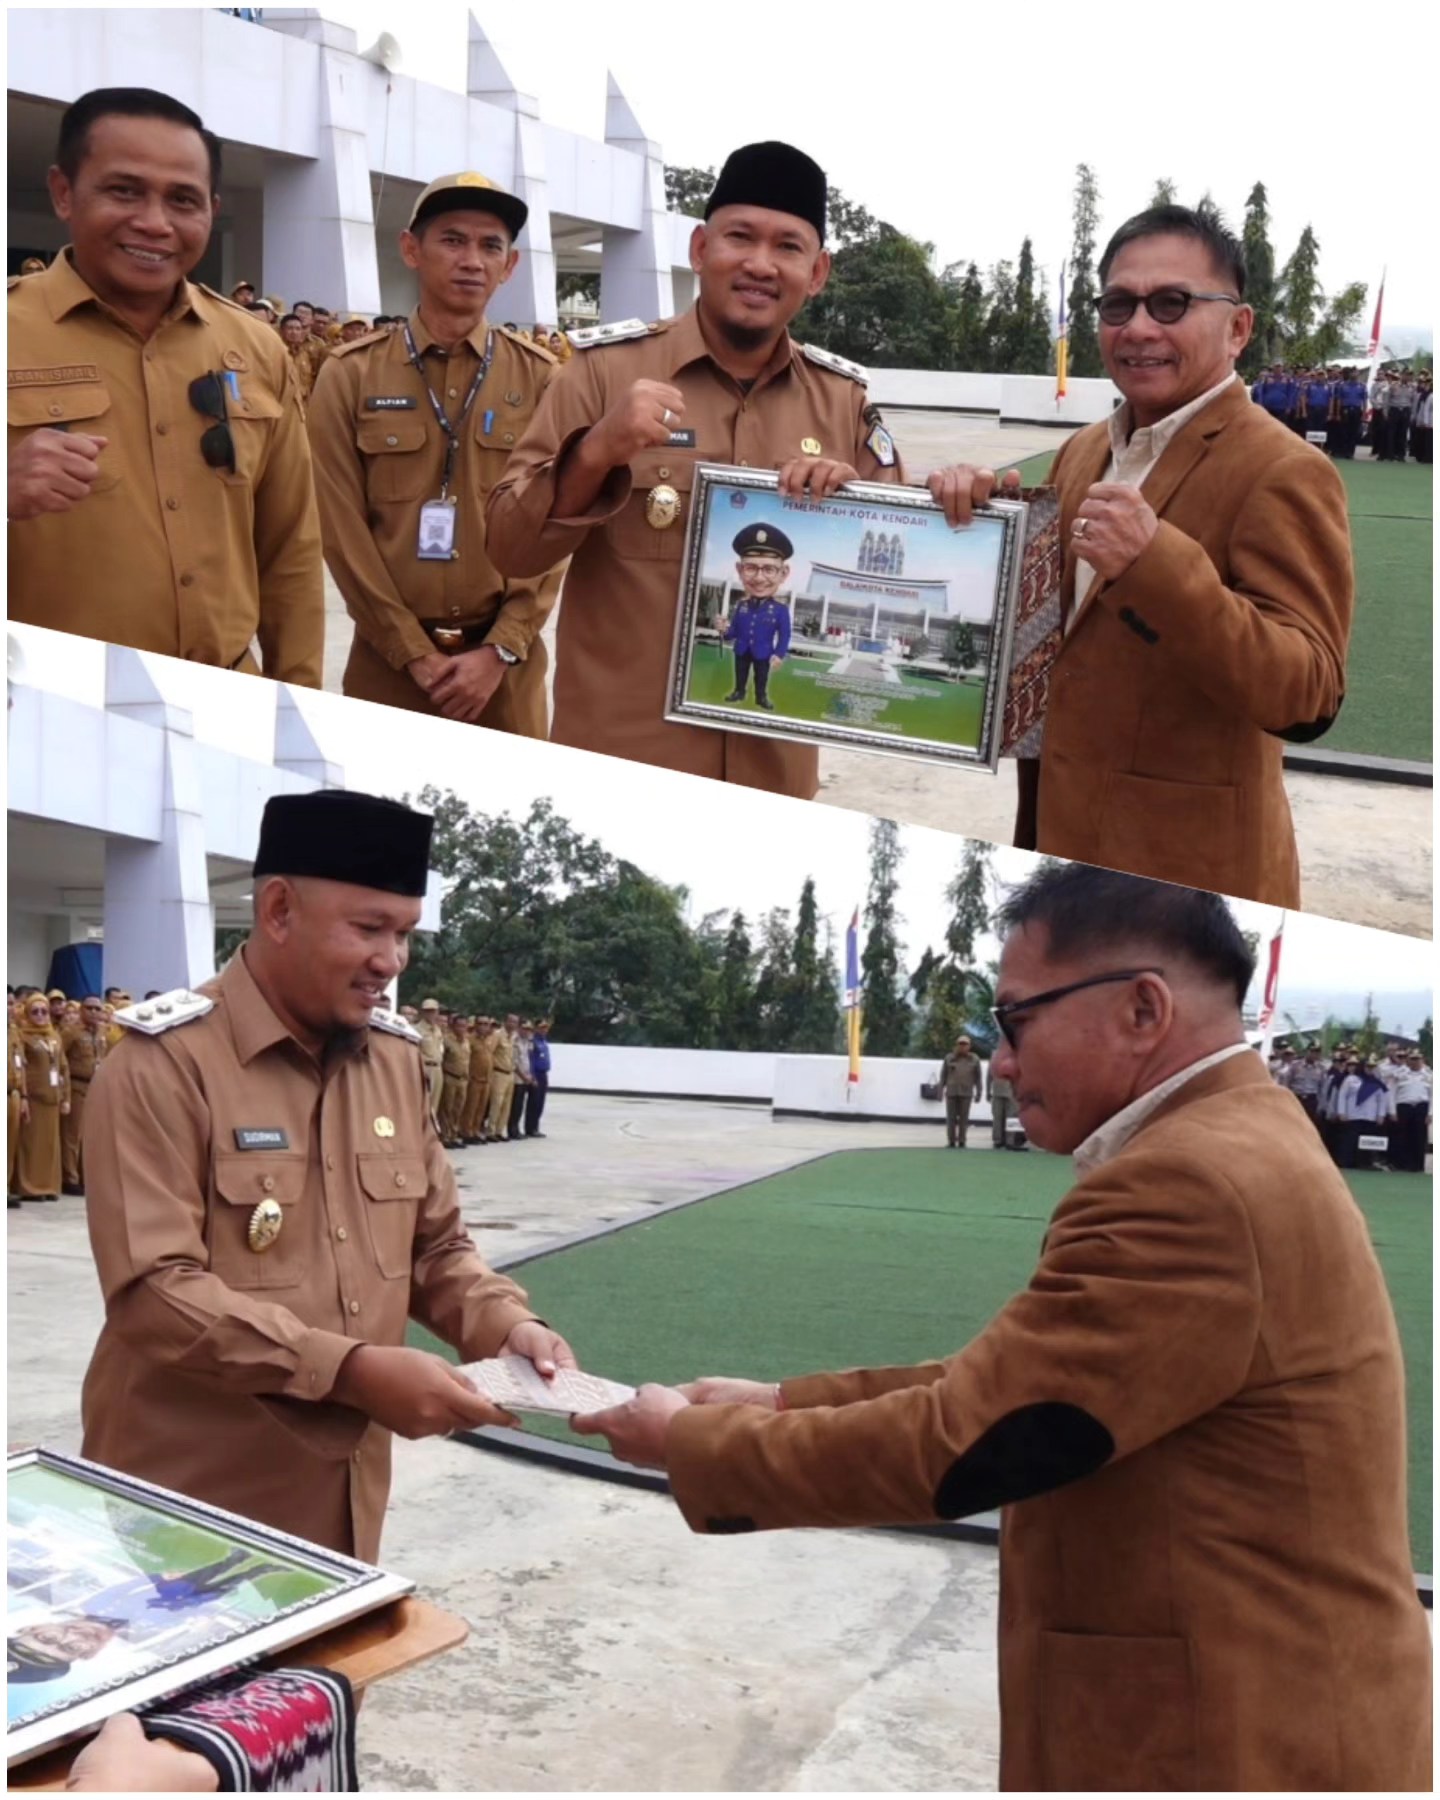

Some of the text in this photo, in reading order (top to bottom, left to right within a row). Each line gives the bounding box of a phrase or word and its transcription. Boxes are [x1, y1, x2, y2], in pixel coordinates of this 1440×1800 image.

[782, 500, 928, 527] PEMERINTAH KOTA KENDARI
